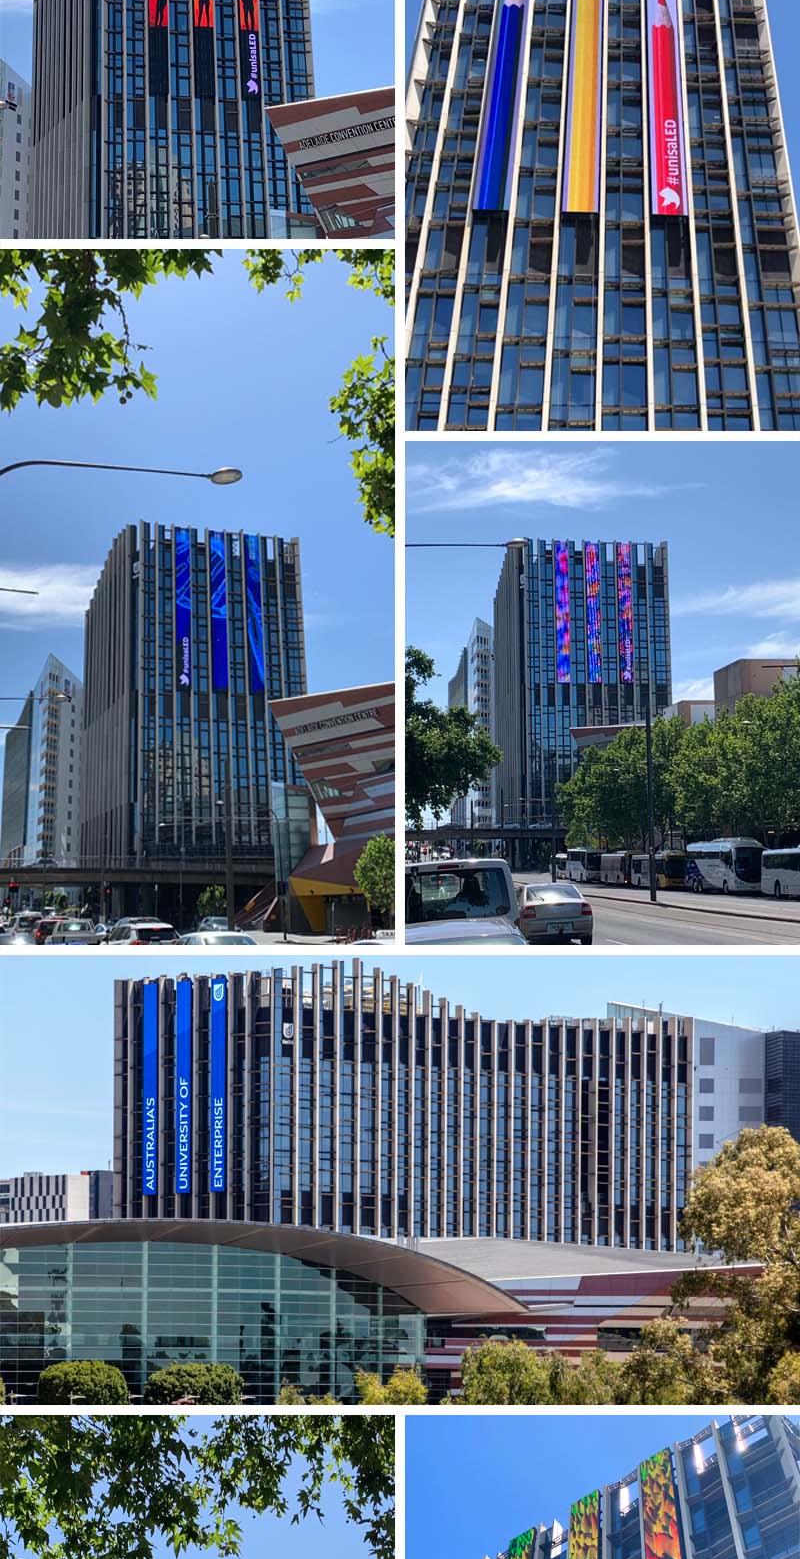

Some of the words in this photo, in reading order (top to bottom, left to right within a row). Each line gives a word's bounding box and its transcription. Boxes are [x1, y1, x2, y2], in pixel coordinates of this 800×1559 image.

[248, 33, 258, 79] #unisaLED
[330, 122, 374, 142] CONVENTION
[664, 119, 680, 185] #unisaLED
[180, 1077, 189, 1099] OF
[146, 1097, 155, 1191] AUSTRALIA'S
[179, 1102, 188, 1189] UNIVERSITY
[214, 1097, 223, 1188] ENTERPRISE
